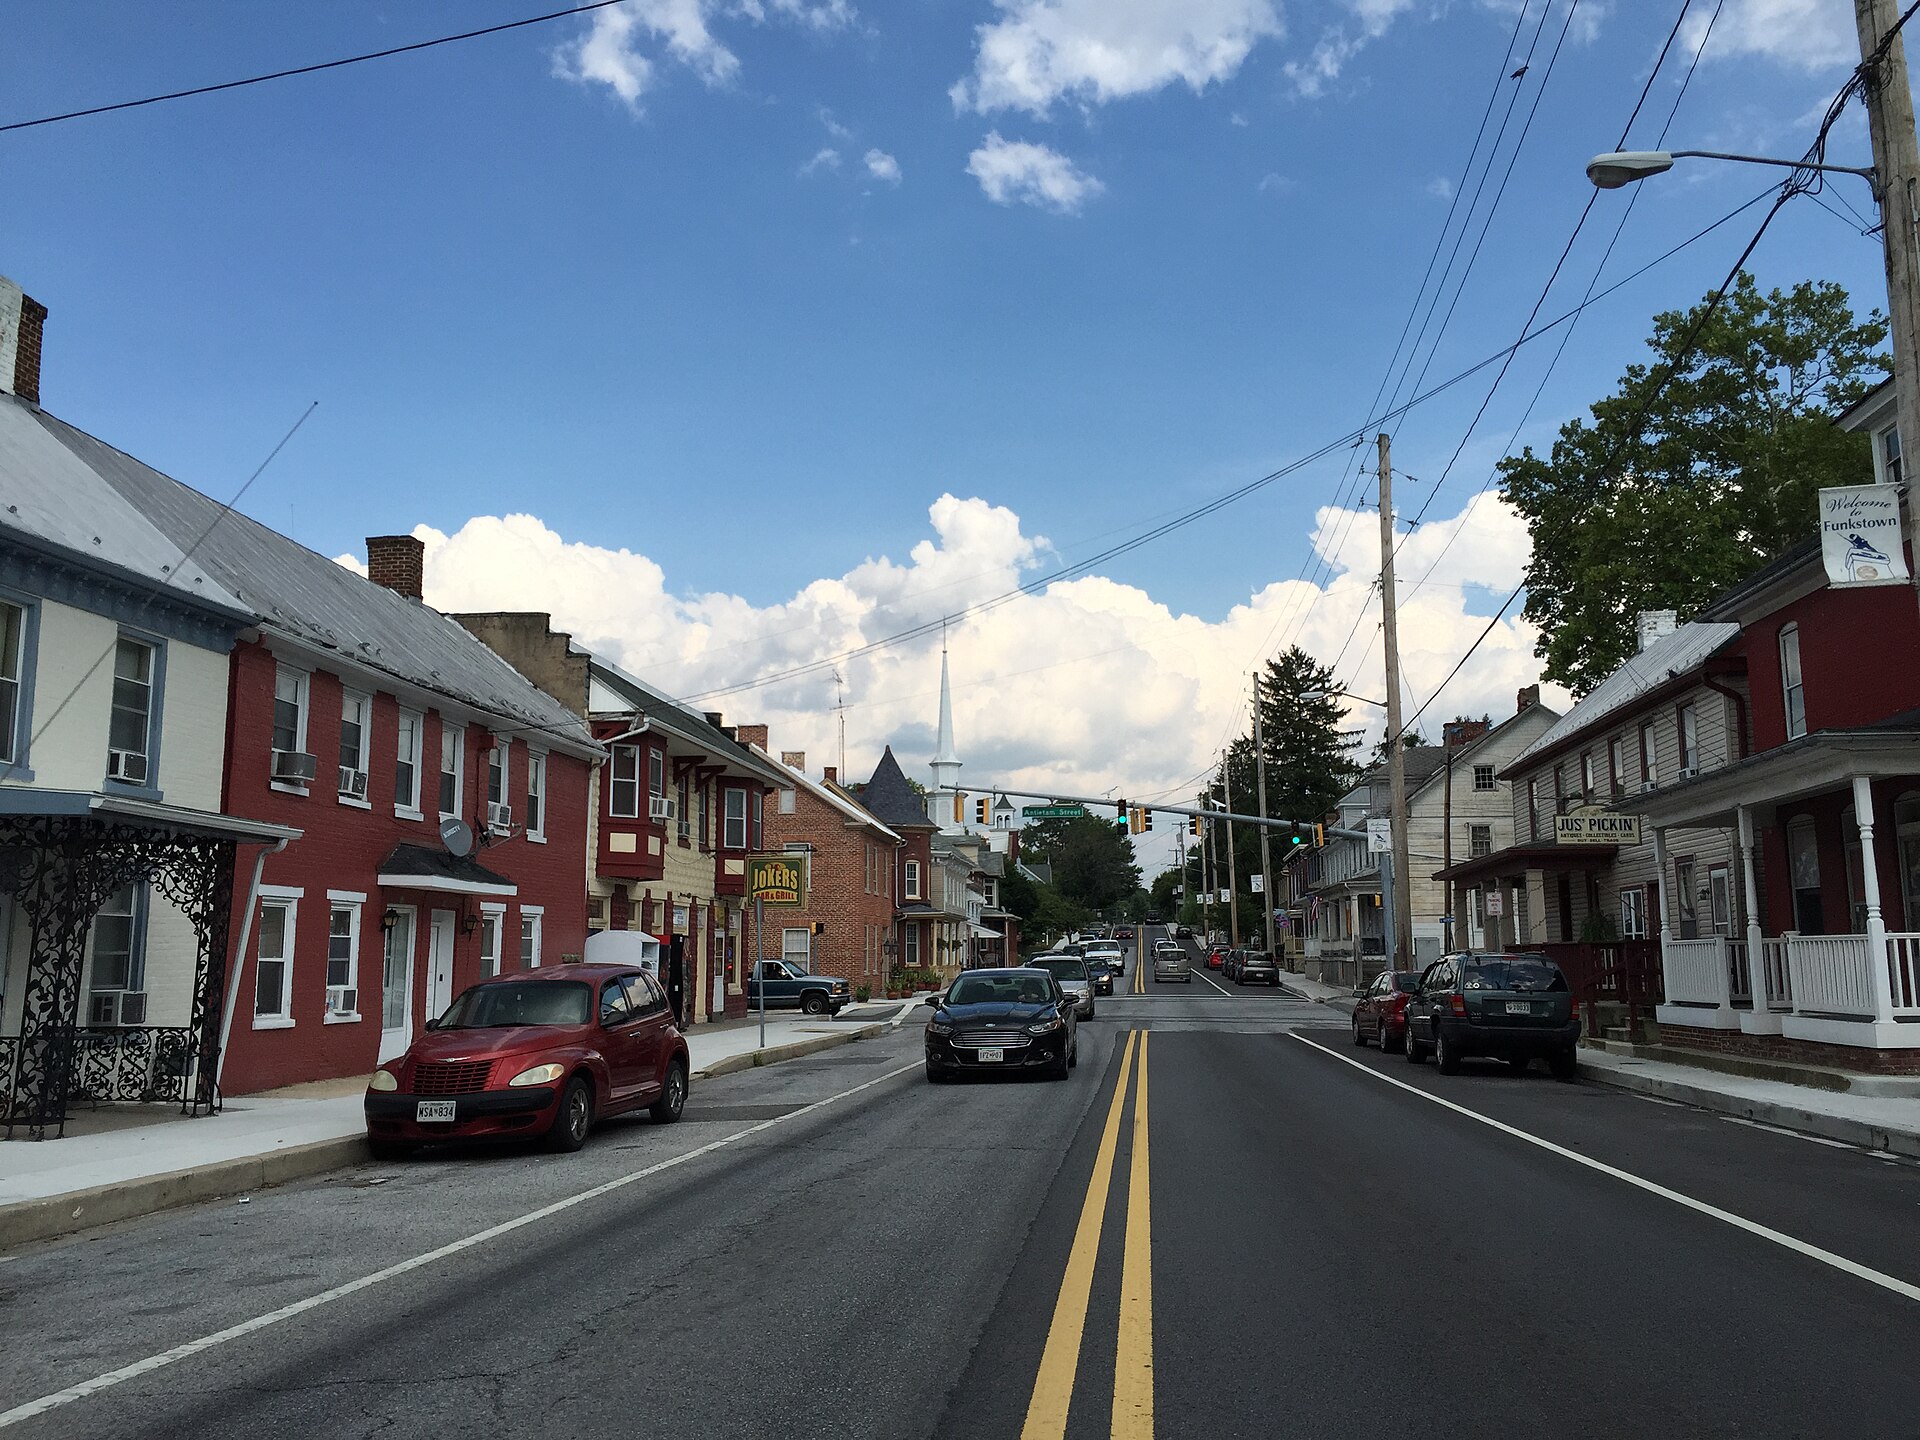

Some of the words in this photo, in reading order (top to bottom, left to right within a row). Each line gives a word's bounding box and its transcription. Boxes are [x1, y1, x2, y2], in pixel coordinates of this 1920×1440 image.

[1826, 494, 1891, 512] Welcome
[1850, 508, 1862, 516] to
[1824, 518, 1897, 532] Funkstown
[1557, 818, 1585, 831] JUS'
[1588, 818, 1636, 831] PICKIN'
[752, 868, 798, 890] JOKERS
[775, 891, 795, 899] GRILL
